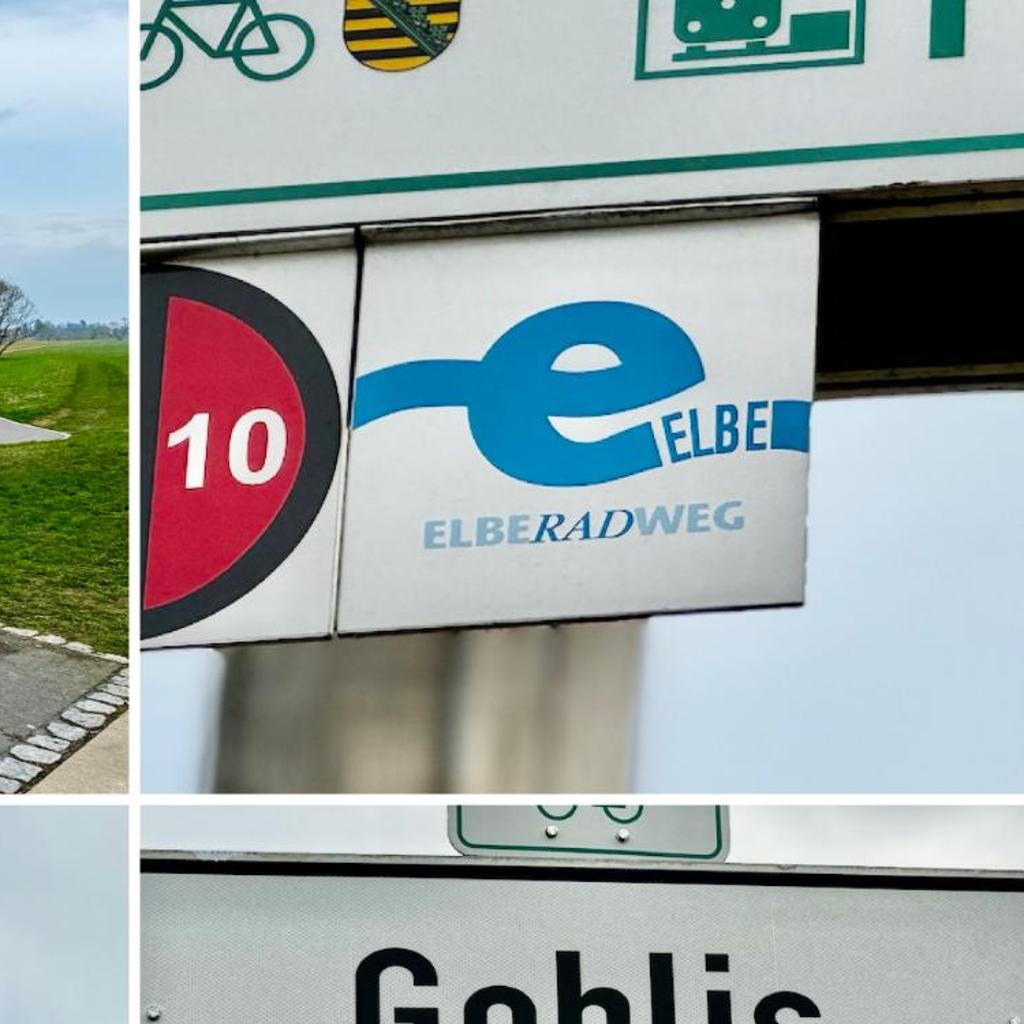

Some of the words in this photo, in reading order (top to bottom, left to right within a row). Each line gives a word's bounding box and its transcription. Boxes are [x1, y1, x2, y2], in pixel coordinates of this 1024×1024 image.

[167, 408, 287, 490] 10
[660, 400, 769, 464] ELBE
[423, 500, 745, 550] ELBERADWEG
